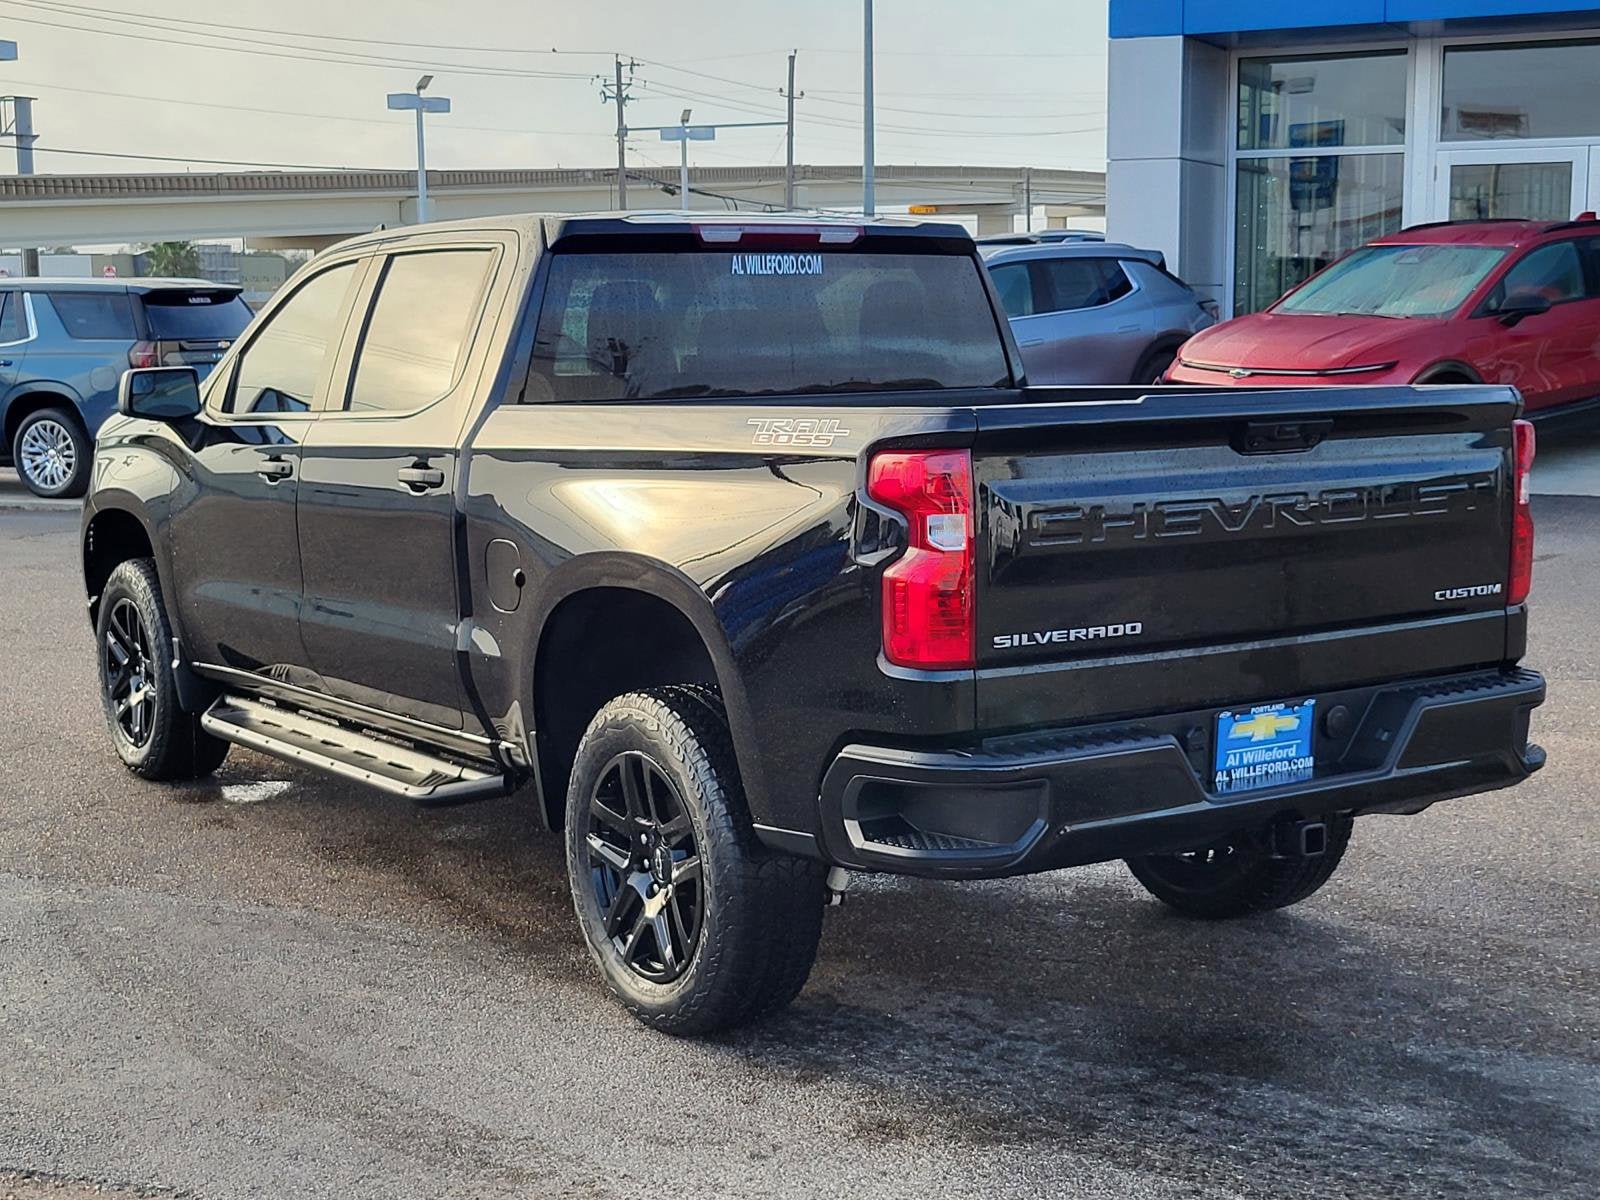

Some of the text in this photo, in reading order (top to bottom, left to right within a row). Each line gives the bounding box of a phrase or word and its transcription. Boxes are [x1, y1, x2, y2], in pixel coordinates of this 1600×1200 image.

[731, 254, 823, 275] AL WILLEFORD.COM
[747, 418, 850, 436] TRAIL
[752, 432, 835, 447] BOSS
[1028, 479, 1496, 547] CHEVROLET
[1434, 583, 1502, 601] CUSTOM
[993, 622, 1143, 649] SILVERADO
[1250, 703, 1286, 715] PORTLAND
[1225, 744, 1297, 768] Al Willeford
[1215, 756, 1315, 782] AL WILLEFORD.COM
